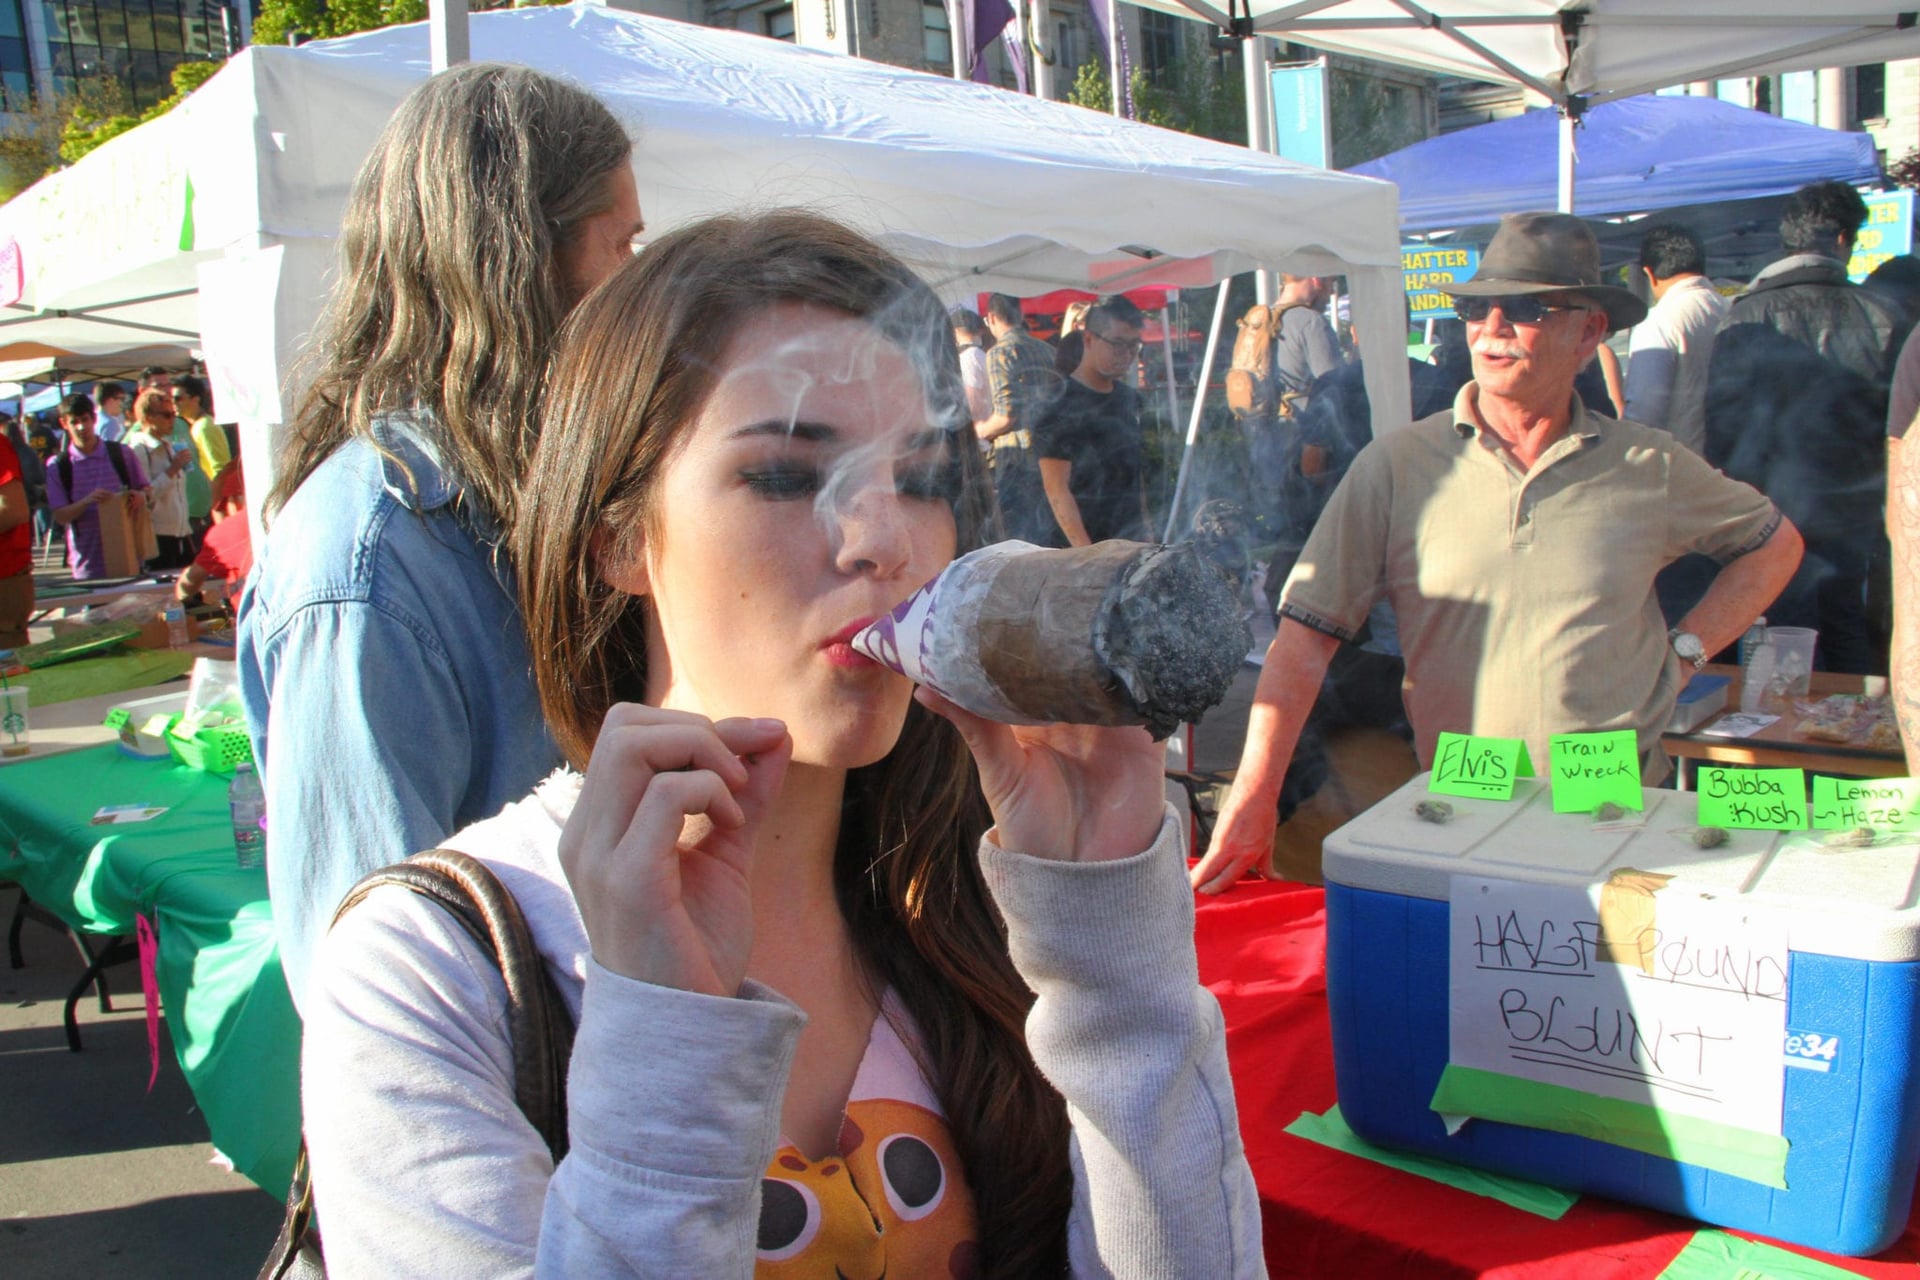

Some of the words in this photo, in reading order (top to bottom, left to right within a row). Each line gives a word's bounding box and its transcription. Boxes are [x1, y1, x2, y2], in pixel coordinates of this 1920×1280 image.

[1436, 738, 1508, 783] Elvis
[1707, 769, 1784, 798] Bubba
[1835, 781, 1904, 801] Lemon
[1473, 910, 1605, 970] HALF
[1635, 927, 1788, 1001] POUND
[1499, 988, 1733, 1075] BLUNT
[1785, 1031, 1838, 1061] e34
